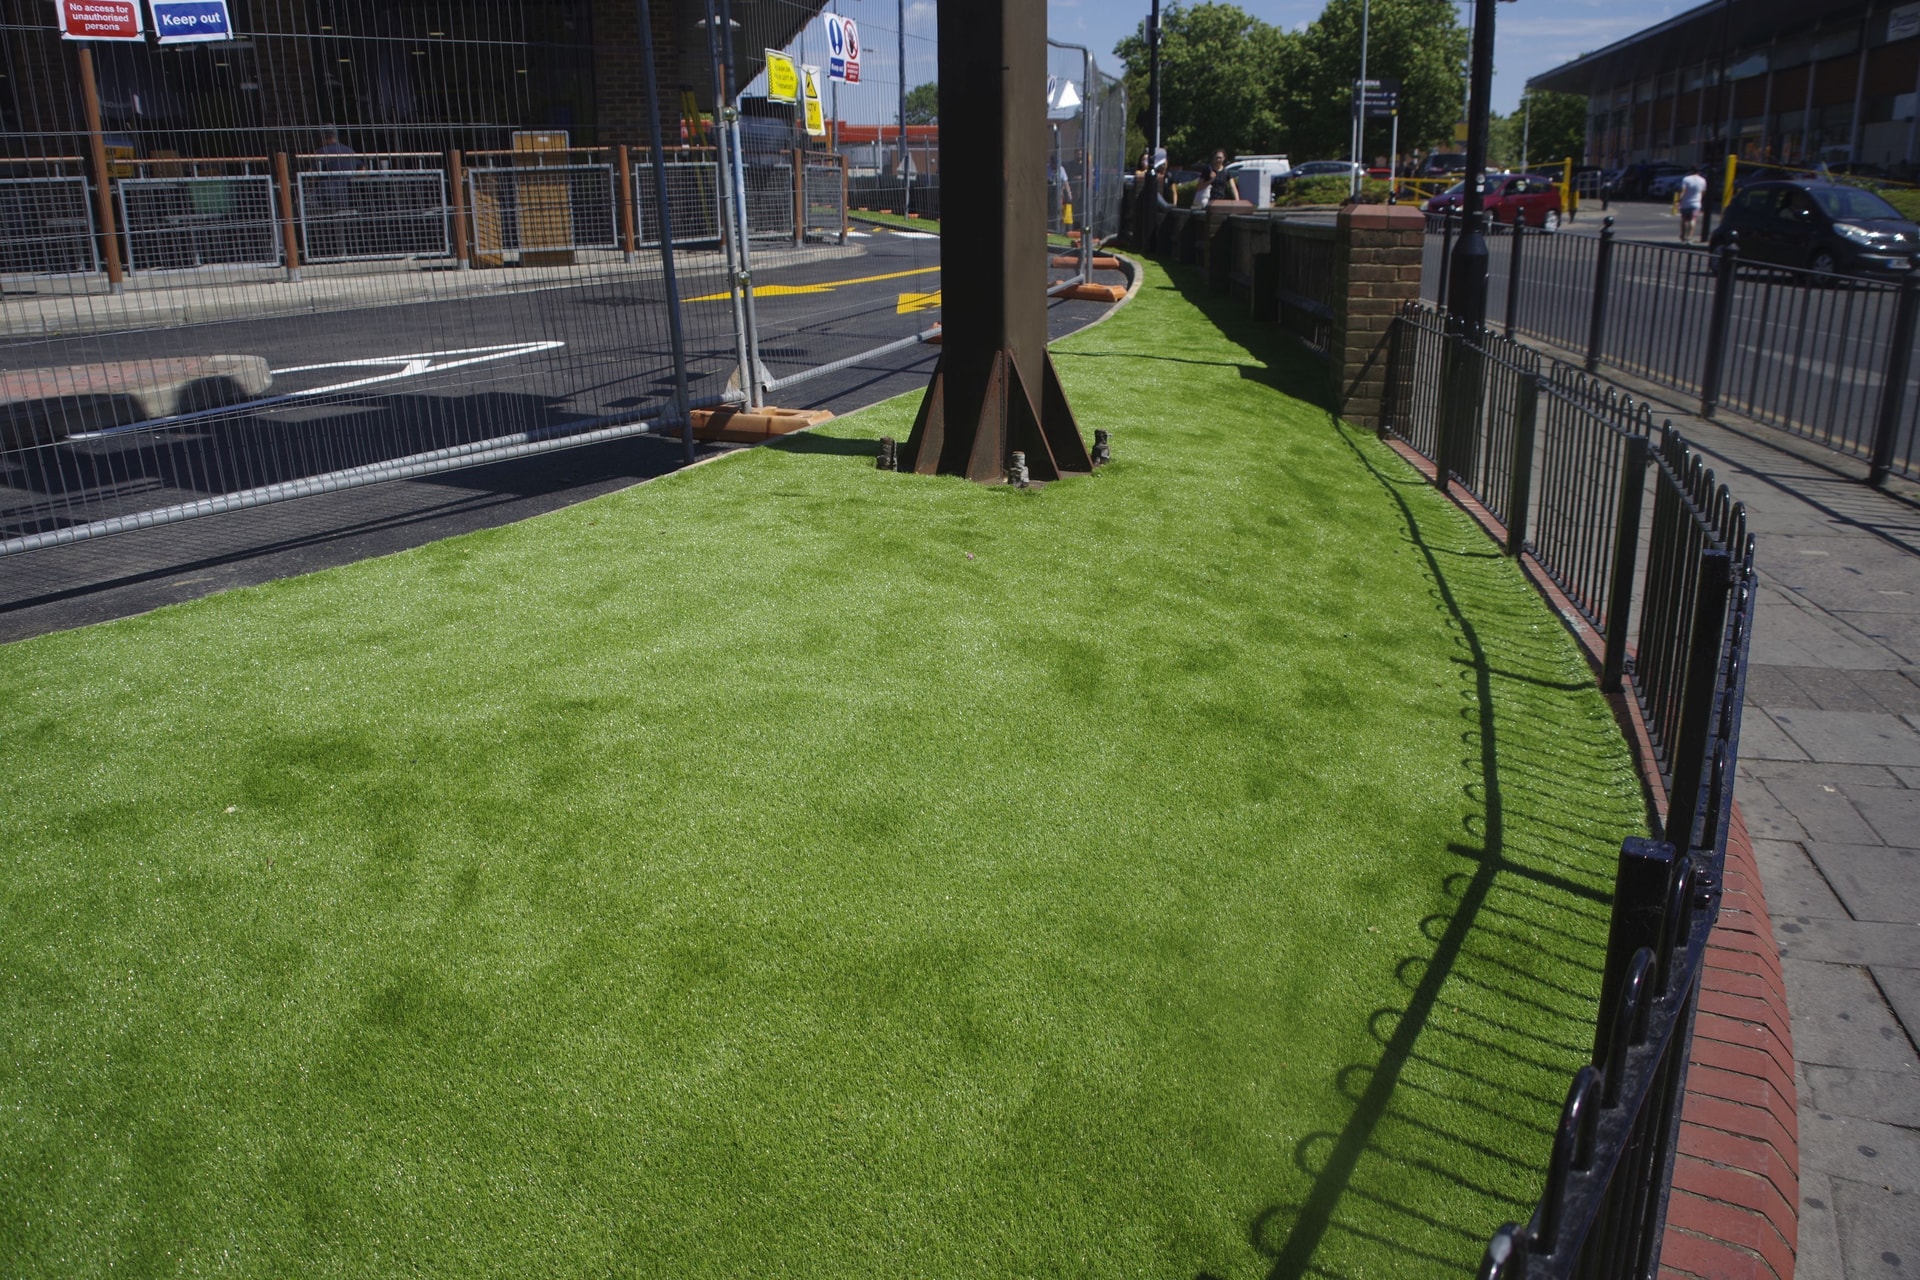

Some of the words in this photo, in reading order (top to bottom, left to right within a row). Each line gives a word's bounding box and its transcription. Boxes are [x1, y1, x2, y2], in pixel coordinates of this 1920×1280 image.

[69, 3, 83, 11] No
[84, 5, 115, 13] access
[116, 5, 128, 13] for
[72, 13, 129, 22] unauthorised
[162, 14, 197, 26] Keep
[200, 12, 221, 23] out
[84, 23, 120, 31] persons
